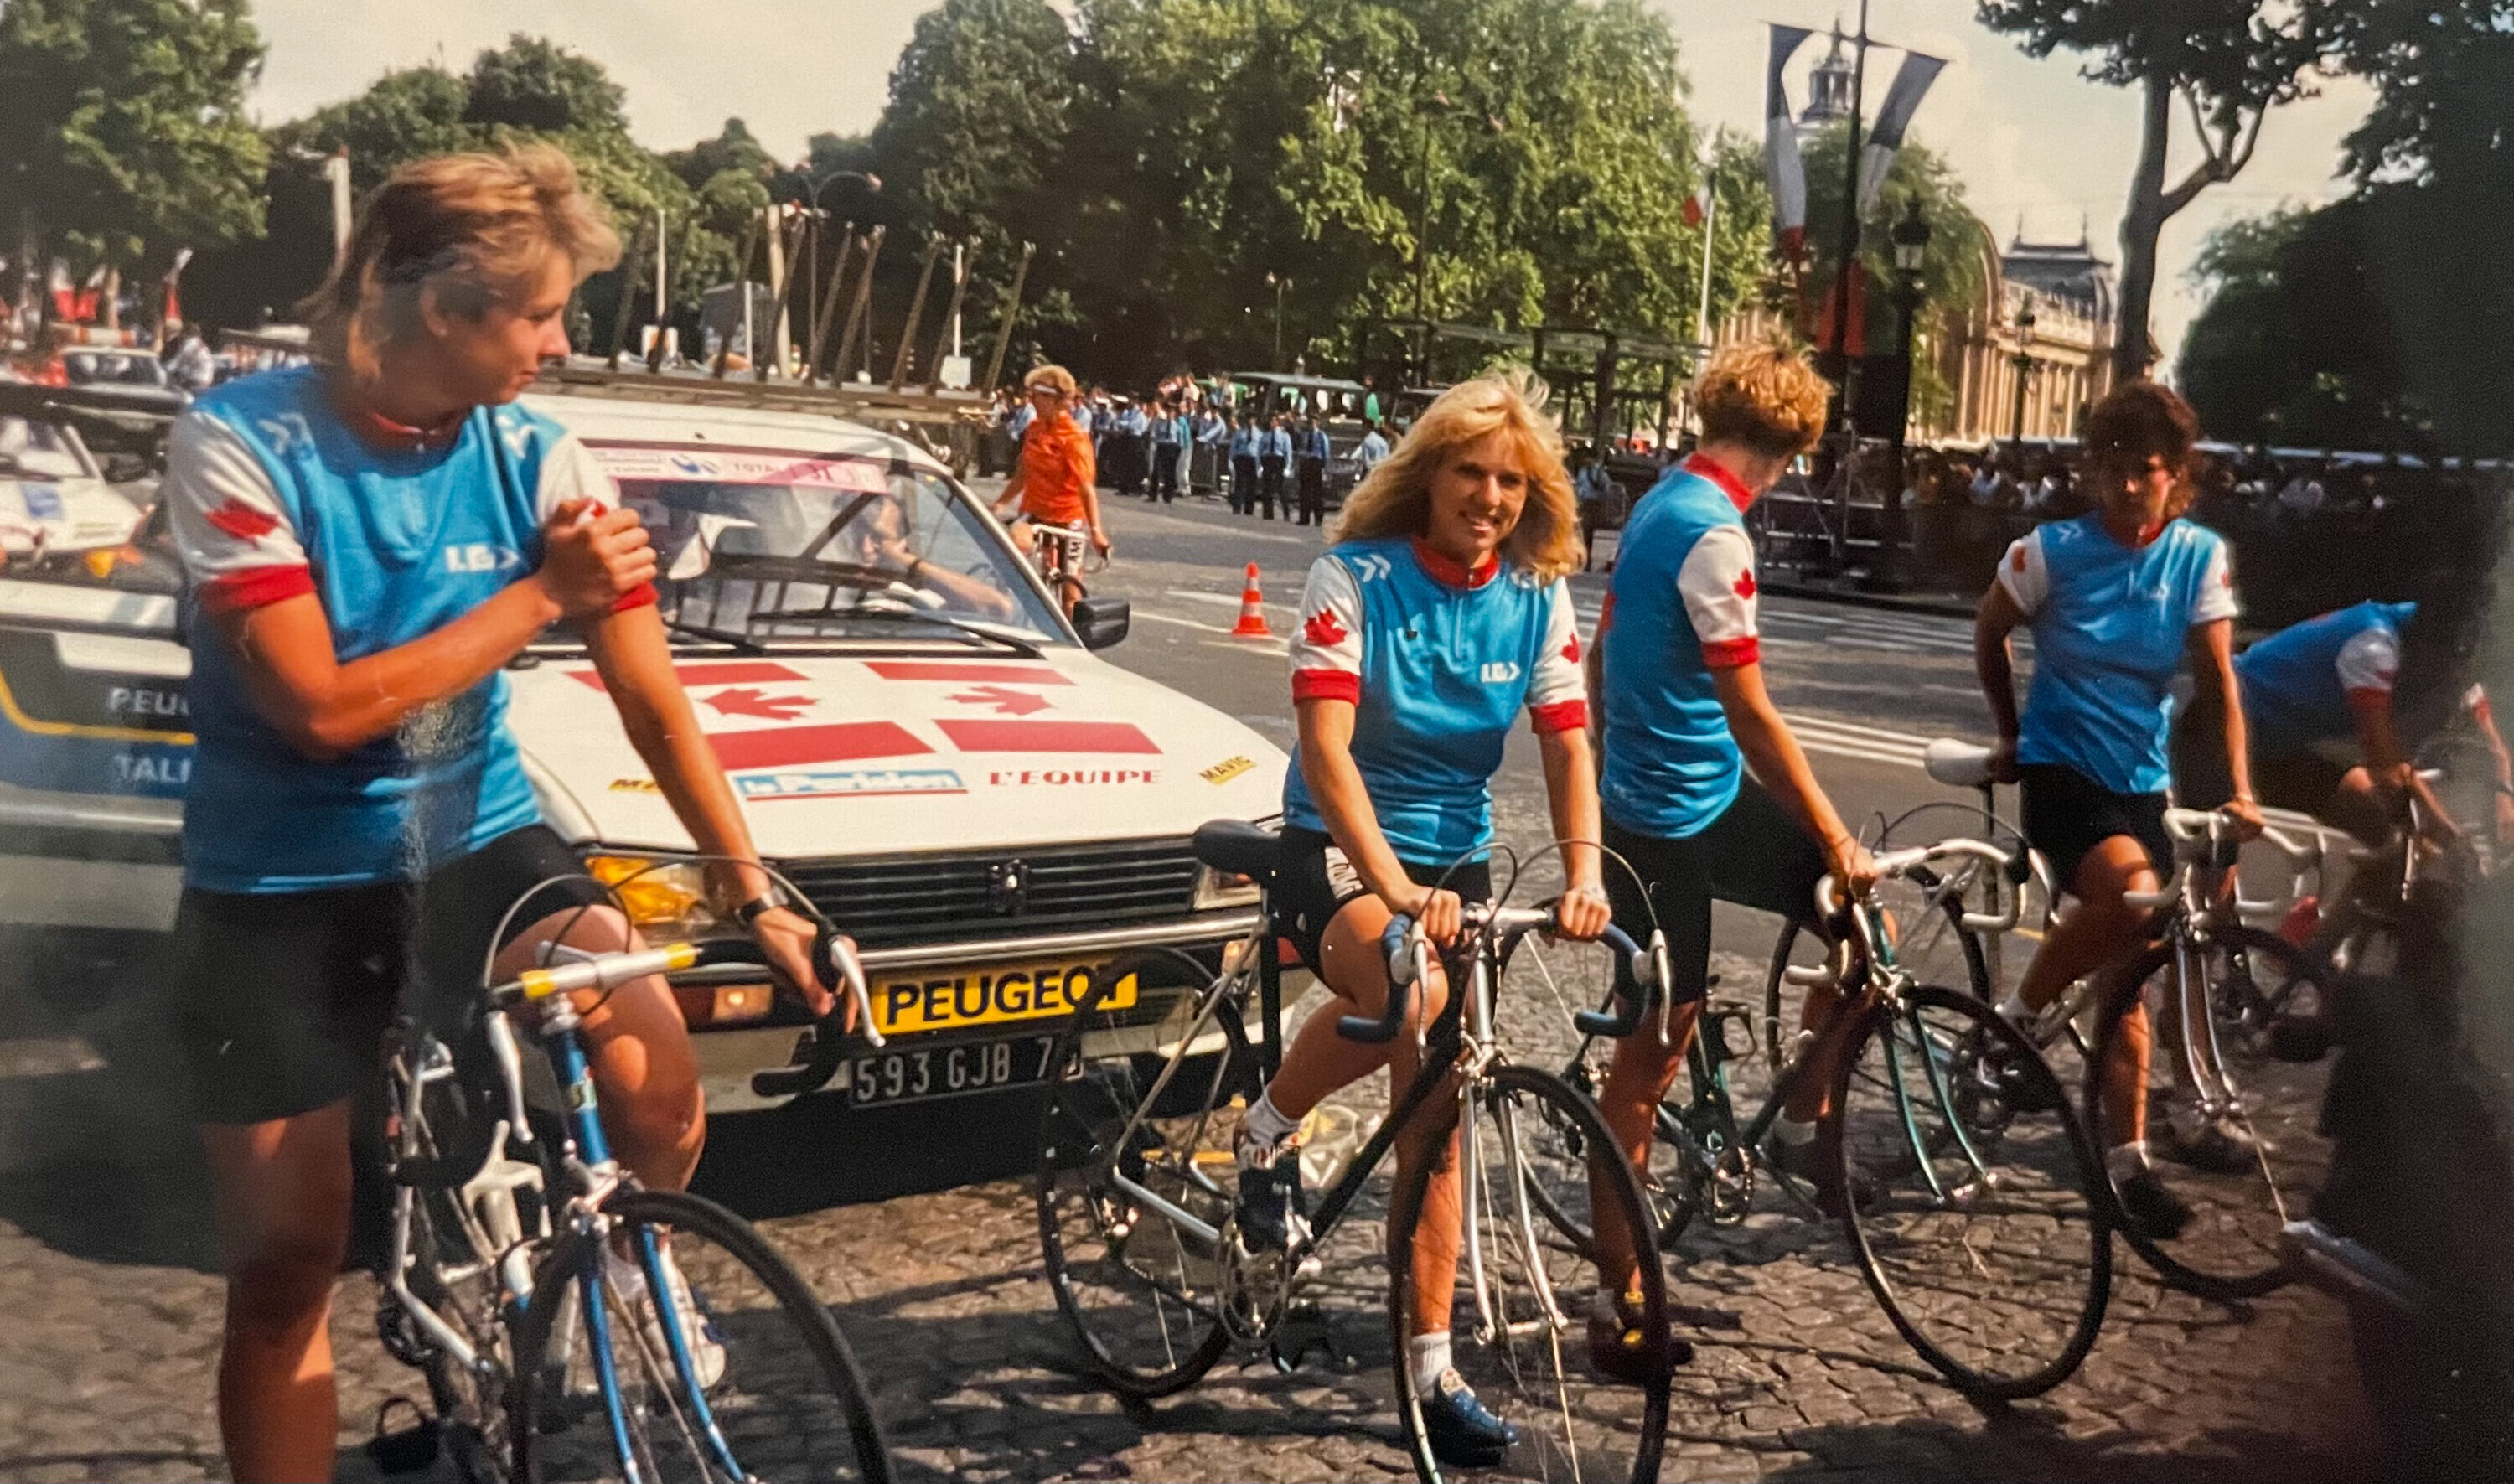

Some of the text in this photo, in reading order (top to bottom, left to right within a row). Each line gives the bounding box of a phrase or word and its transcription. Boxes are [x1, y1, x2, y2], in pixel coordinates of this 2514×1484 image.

[989, 769, 1161, 786] L'EQUIPE
[857, 1052, 931, 1102] 593
[948, 1043, 1011, 1089] GJB
